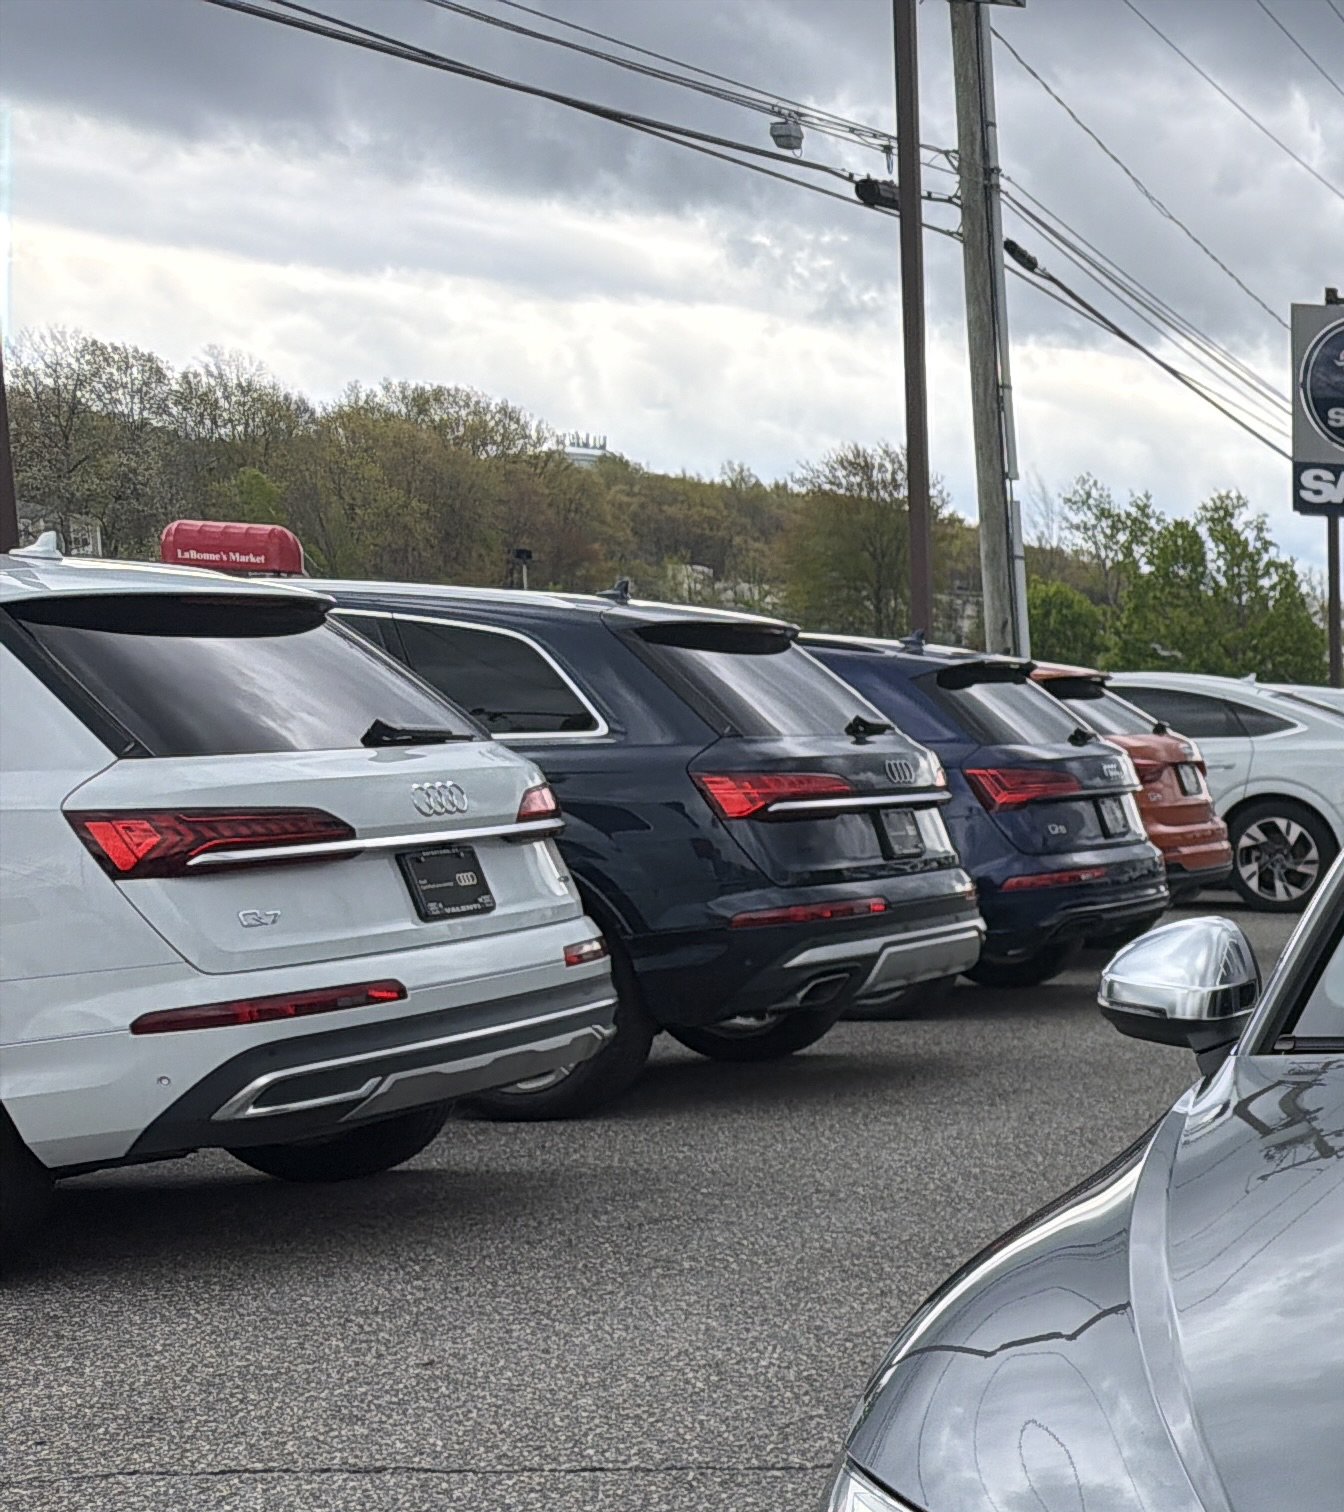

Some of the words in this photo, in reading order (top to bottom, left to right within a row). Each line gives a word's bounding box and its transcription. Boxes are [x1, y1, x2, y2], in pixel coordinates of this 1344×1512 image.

[177, 549, 227, 561] LaBonne's
[229, 552, 265, 564] Market
[238, 909, 281, 928] Q7
